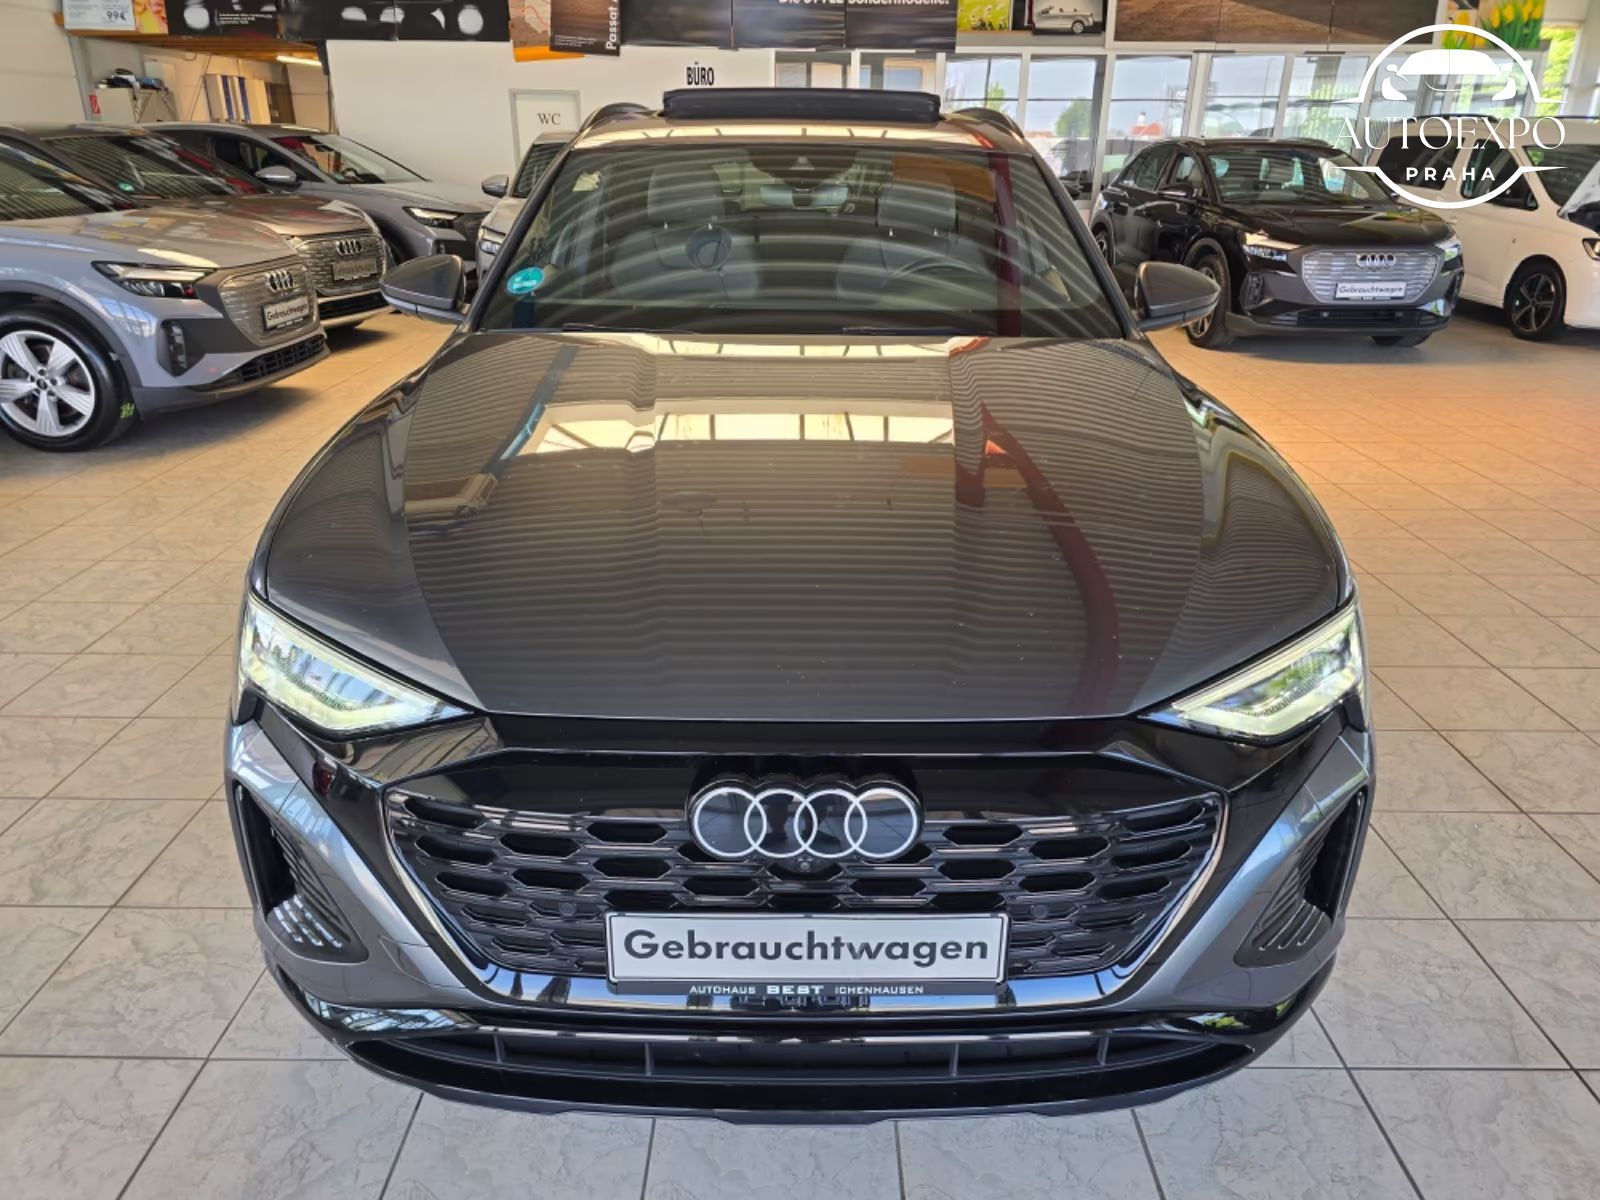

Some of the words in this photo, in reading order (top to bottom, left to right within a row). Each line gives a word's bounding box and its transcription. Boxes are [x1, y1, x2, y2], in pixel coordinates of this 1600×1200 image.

[605, 6, 618, 50] Passat
[686, 61, 715, 86] BÜRO
[537, 113, 561, 125] WC
[624, 929, 988, 967] Gebrauchtwagen
[689, 985, 756, 994] AUTOHAUS
[766, 985, 824, 994] BEST
[835, 986, 924, 994] ICHENHAUSEN
